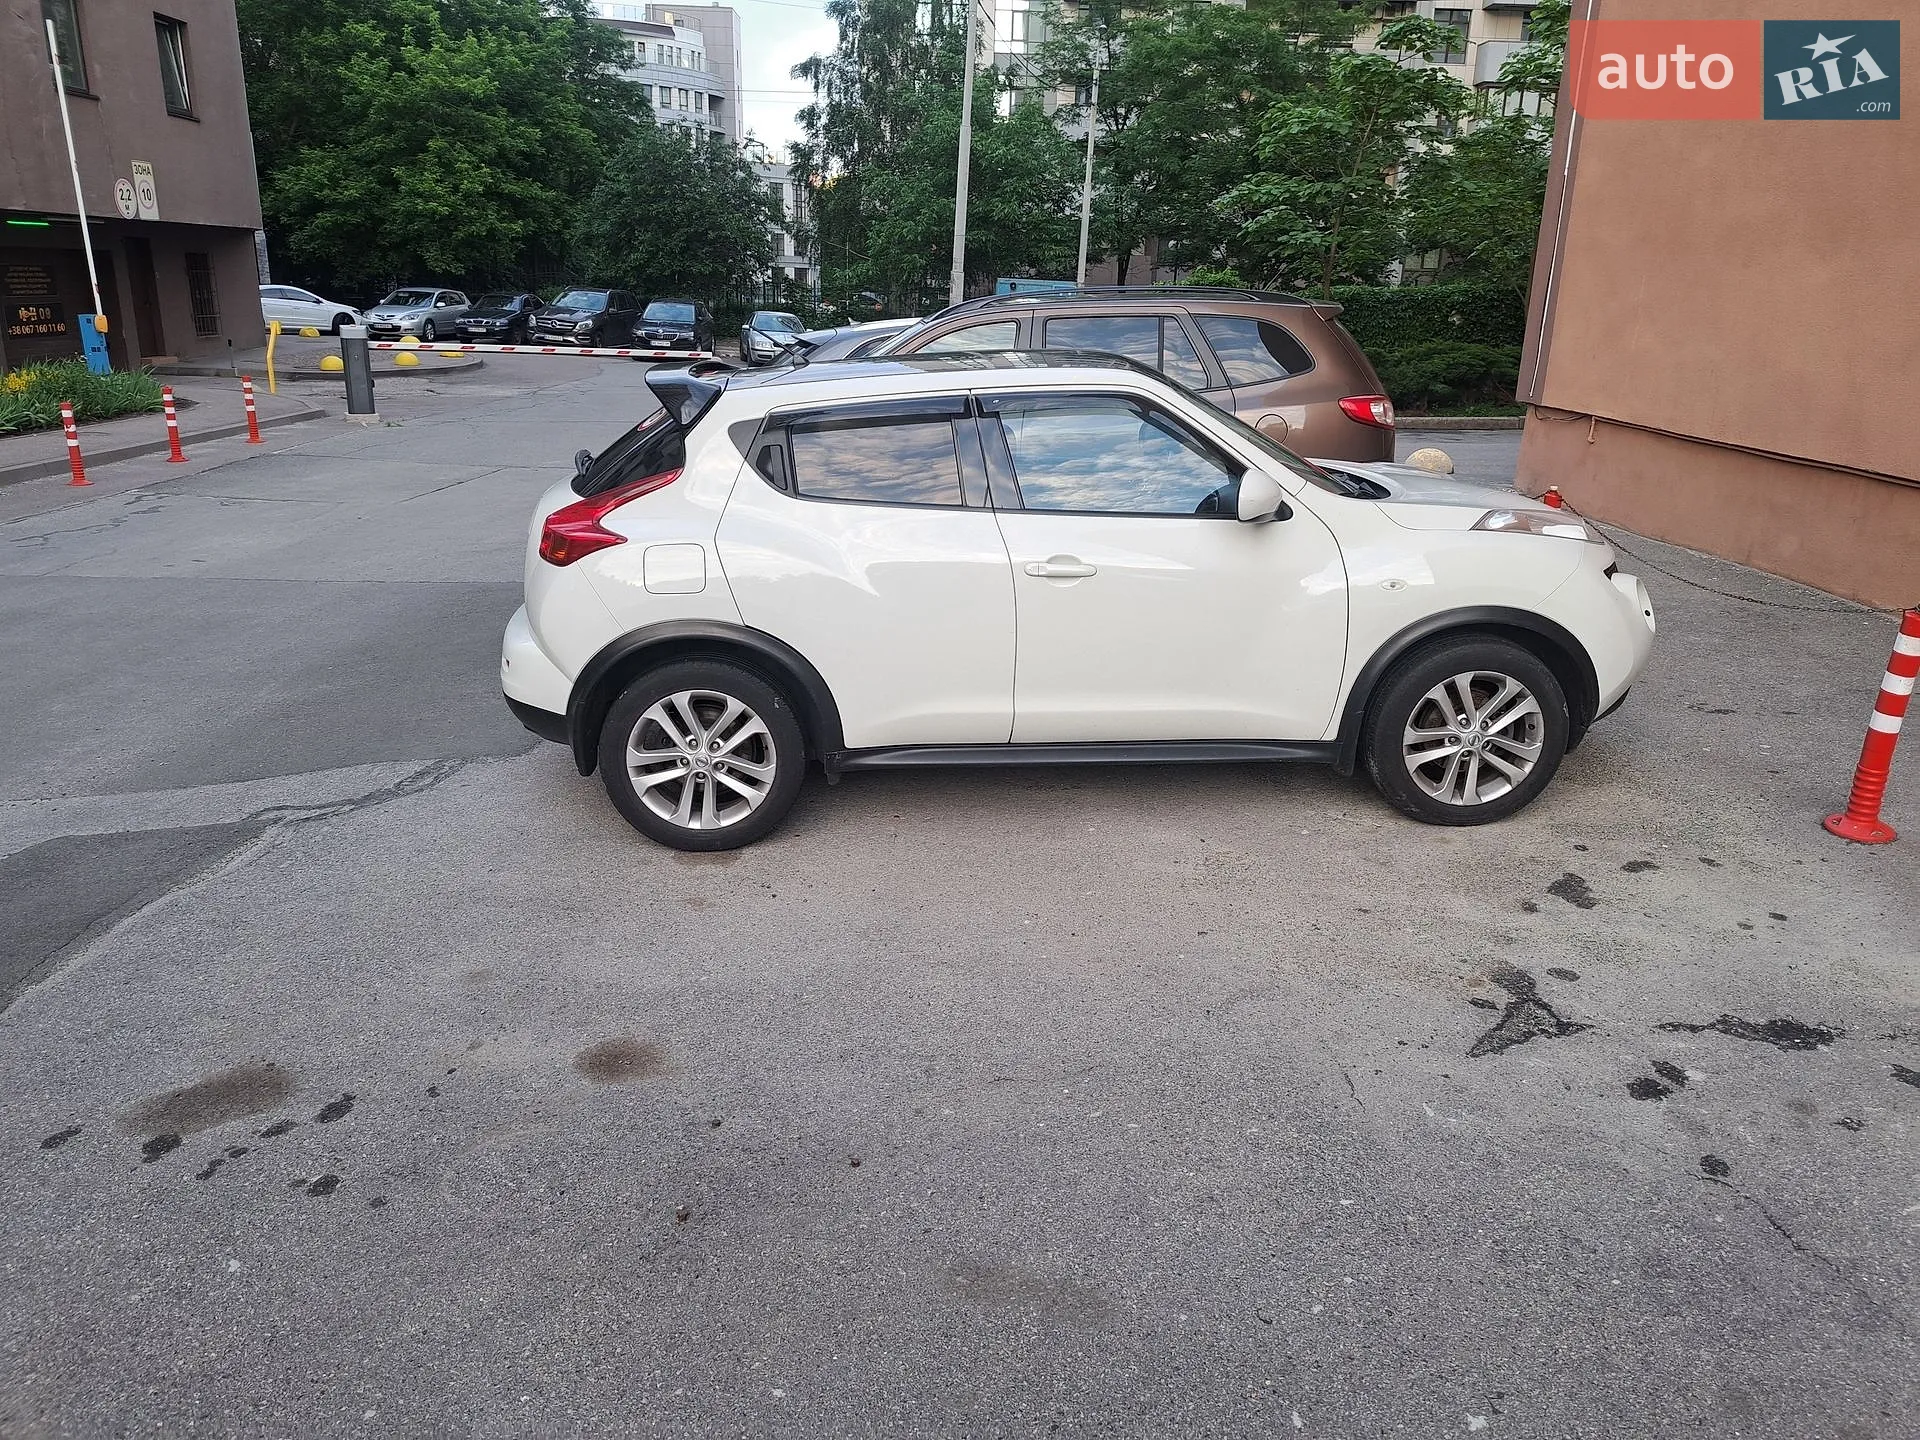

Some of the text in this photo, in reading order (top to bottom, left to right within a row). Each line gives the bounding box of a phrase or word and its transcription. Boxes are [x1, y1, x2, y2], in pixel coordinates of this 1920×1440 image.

[133, 164, 152, 175] ЗОНА
[142, 188, 152, 201] 10
[8, 322, 66, 335] +38 067 160 11 60
